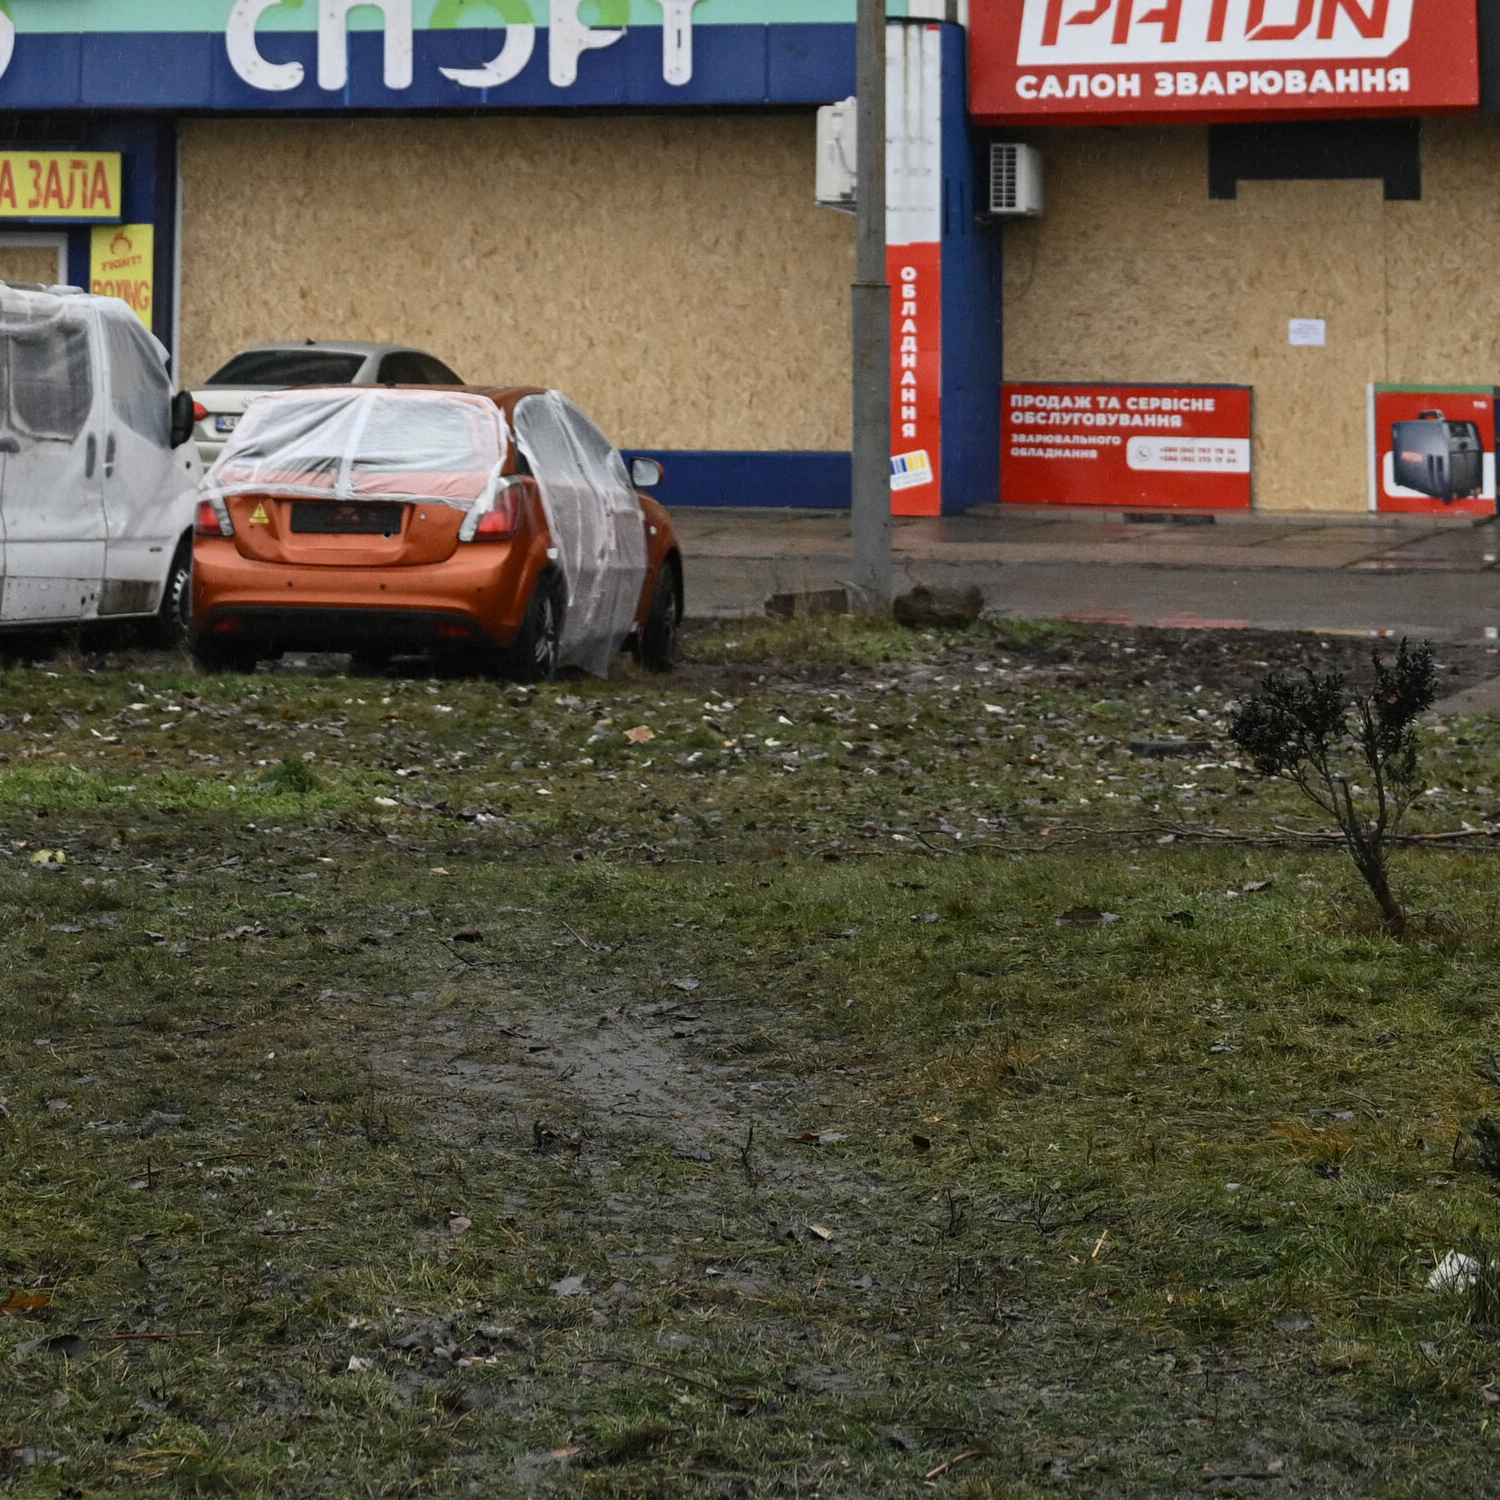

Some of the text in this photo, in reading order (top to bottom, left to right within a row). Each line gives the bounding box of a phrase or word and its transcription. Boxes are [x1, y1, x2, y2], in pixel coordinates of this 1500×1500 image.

[1015, 67, 1410, 99] САЛОН ЗВАРЮВАННЯ
[28, 159, 112, 210] ЗАЛА
[900, 266, 918, 438] ОБЛАДНАННЯ
[1010, 394, 1215, 412] ПРОДАЖ ТА СЕРВІСНЕ
[1010, 411, 1183, 428] ОБСЛУГОВУВАННЯ
[1010, 433, 1122, 446] ЗВАРЮВАЛЬНОГО
[1010, 446, 1098, 459] ОБЛАДНАННЯ
